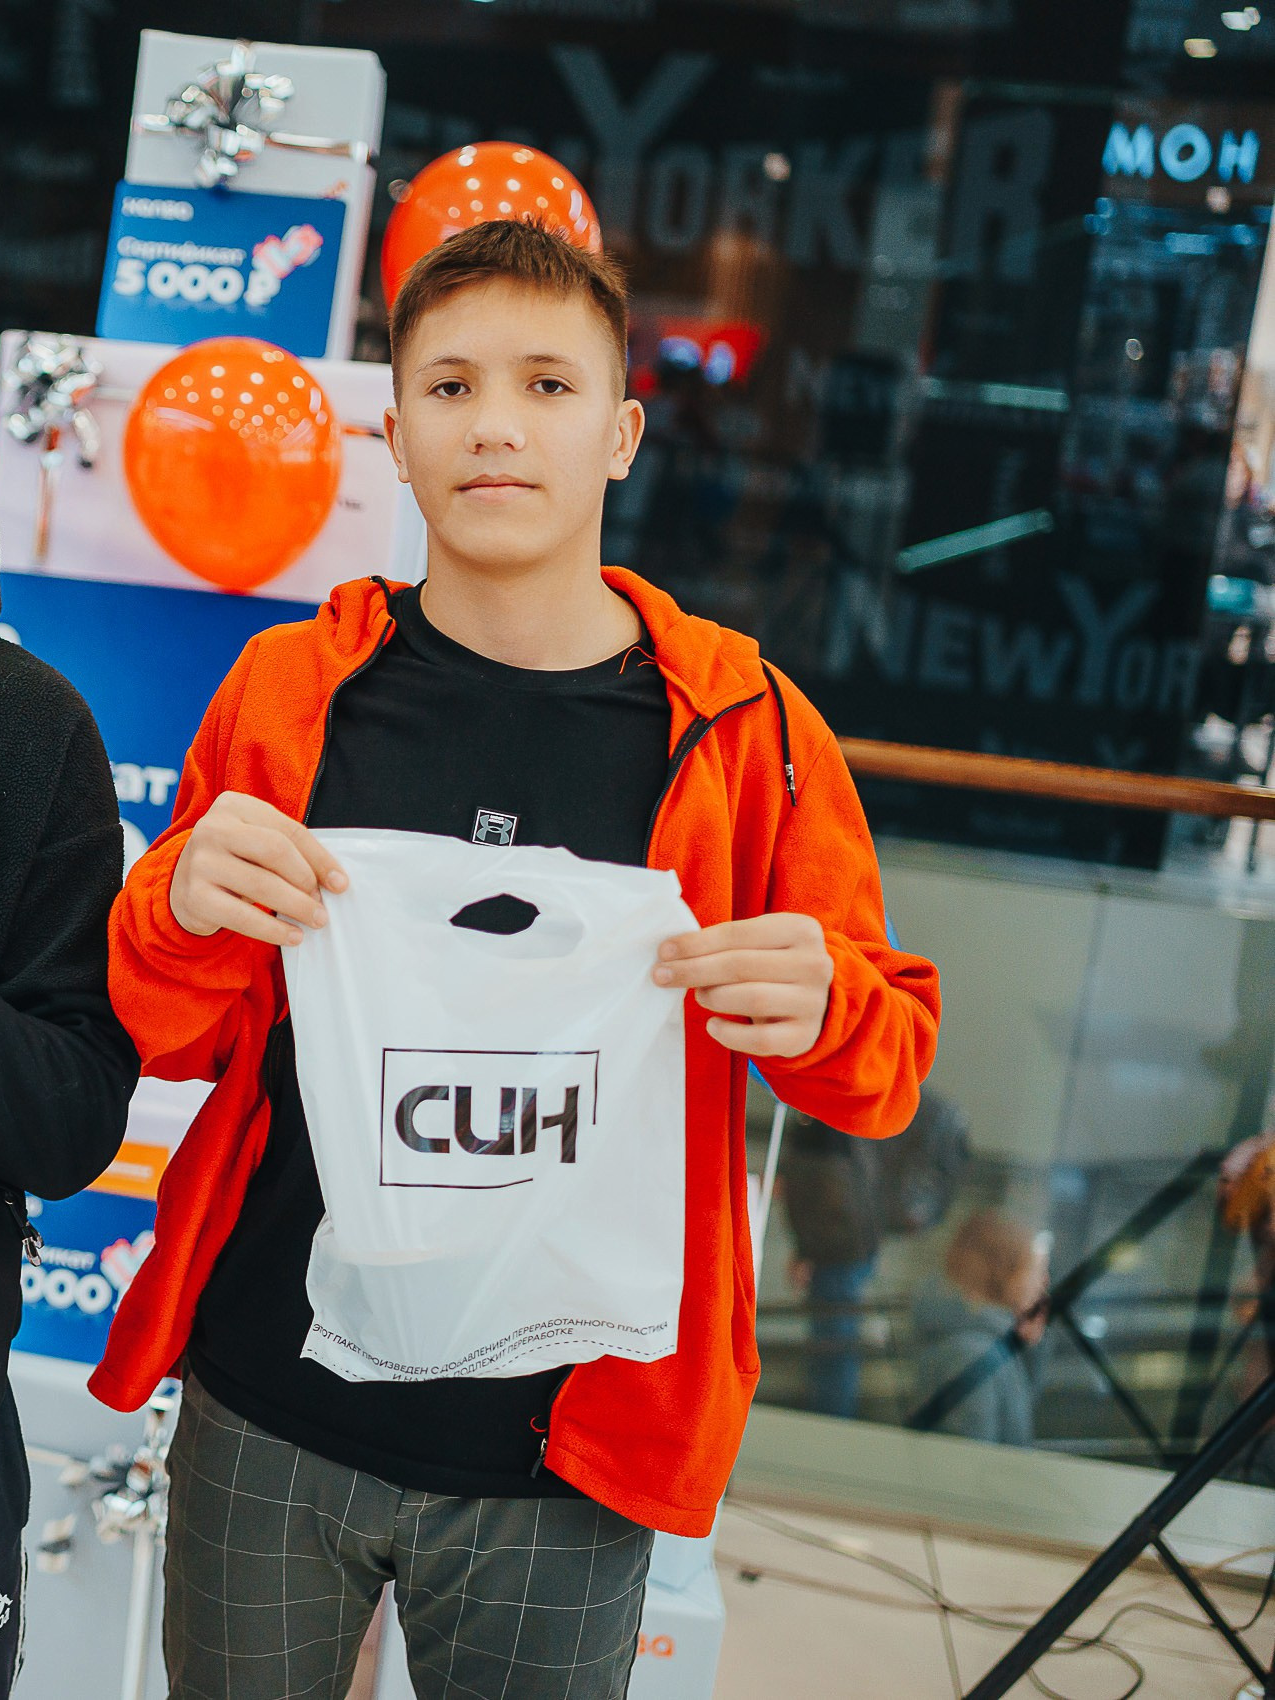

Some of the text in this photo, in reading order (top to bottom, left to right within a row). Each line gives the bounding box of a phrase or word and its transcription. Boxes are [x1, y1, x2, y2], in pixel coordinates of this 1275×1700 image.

[312, 1323, 334, 1340] ЭТОТ
[332, 1334, 361, 1354] ПАКЕТ
[362, 1351, 429, 1375] ПРОИЗВЕДЕН
[440, 1334, 511, 1374] ДОБАВЛЕНИЕМ
[512, 1318, 615, 1340] ПЕРЕРАБОТАННОГО
[617, 1321, 668, 1336] ПЛАСТИКА
[453, 1348, 507, 1378] ПОДЛЕЖИТ
[507, 1327, 574, 1355] ПЕРЕРАБОТКЕ
